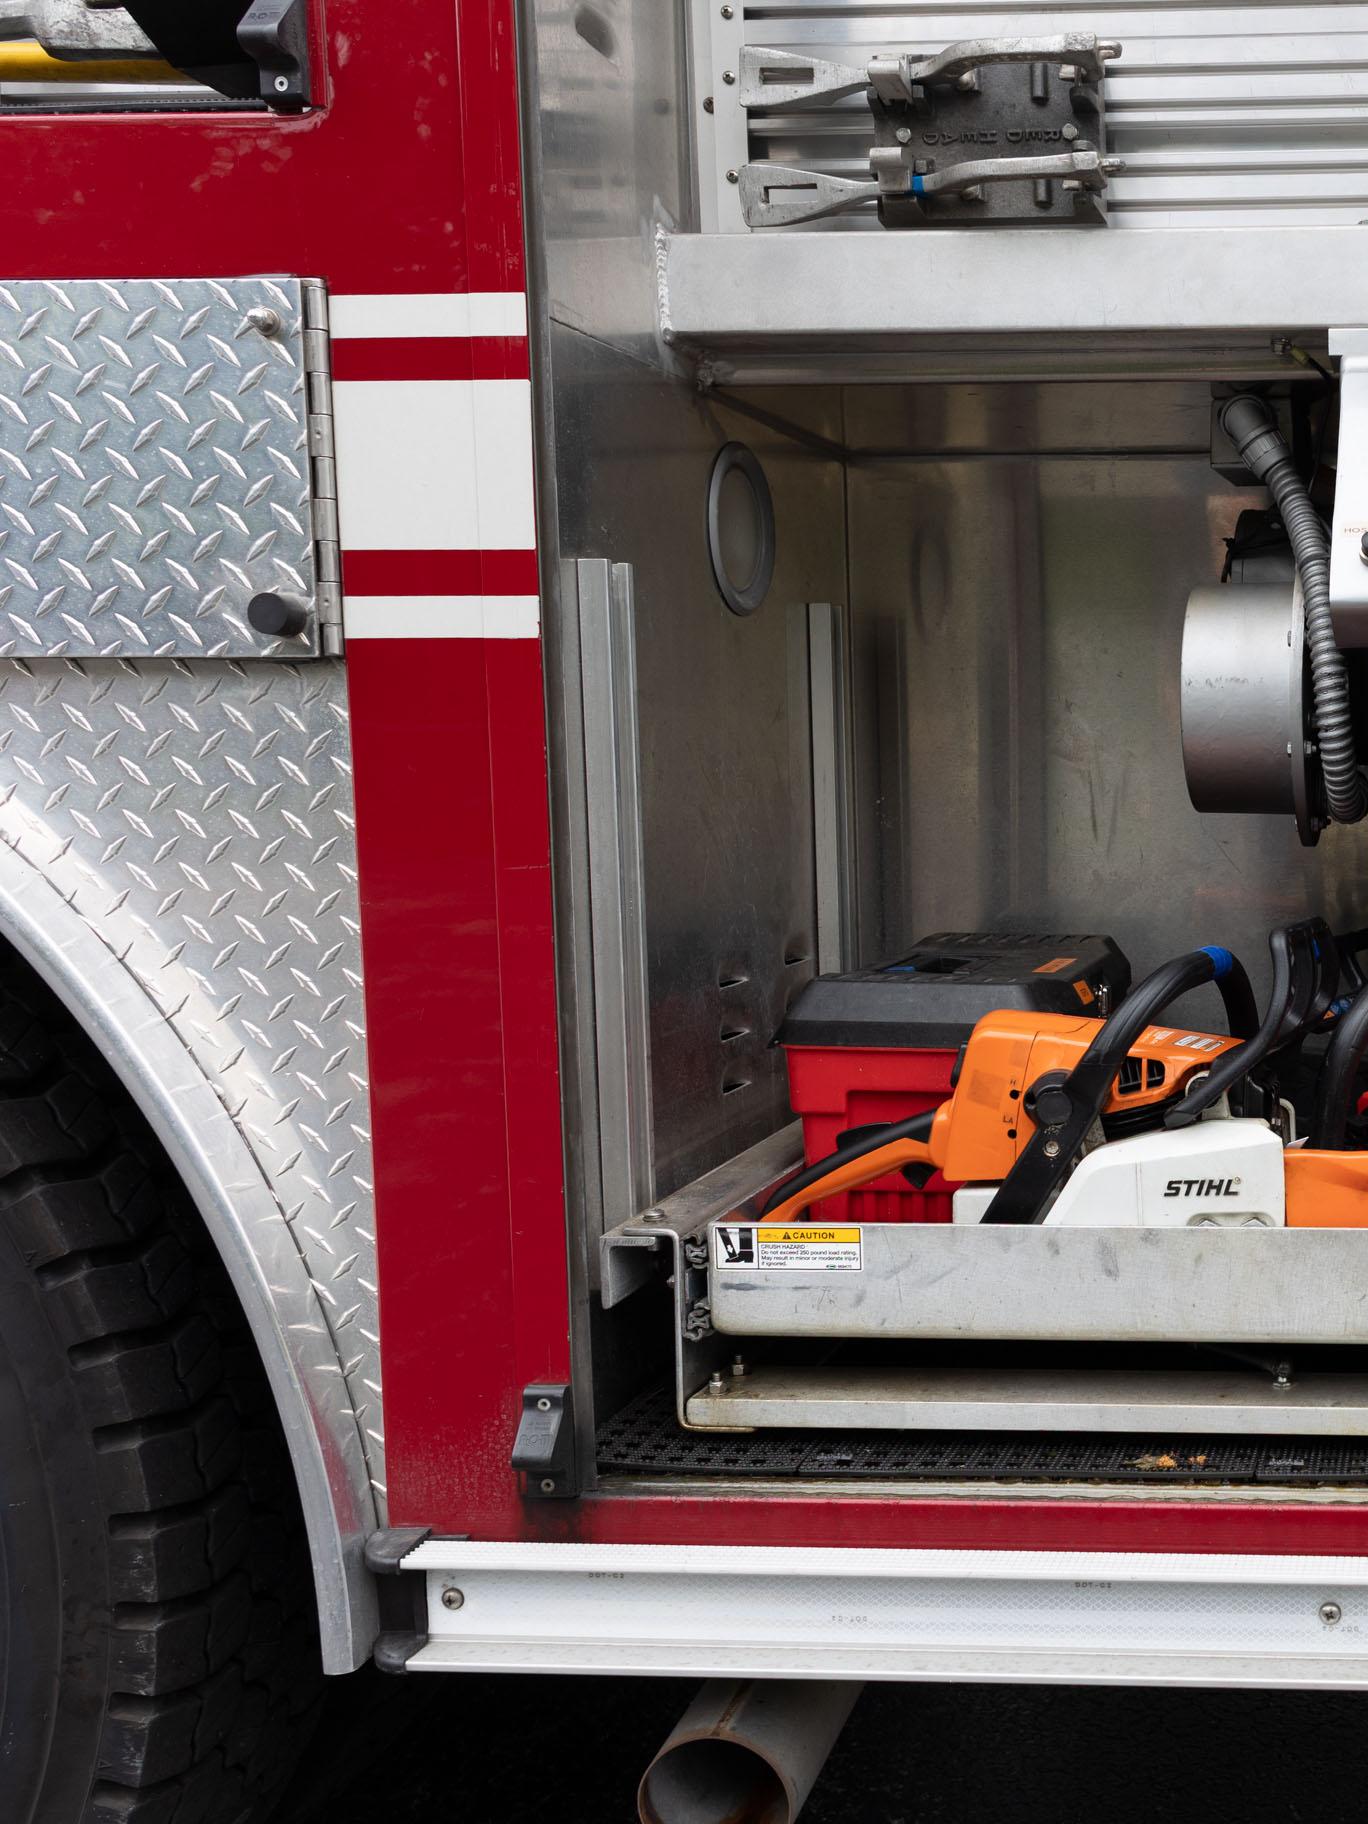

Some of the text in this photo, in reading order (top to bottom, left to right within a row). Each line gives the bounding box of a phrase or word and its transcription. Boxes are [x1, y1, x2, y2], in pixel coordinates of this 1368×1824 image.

[922, 129, 1062, 145] RED HEAD
[1163, 1179, 1240, 1197] STIHL
